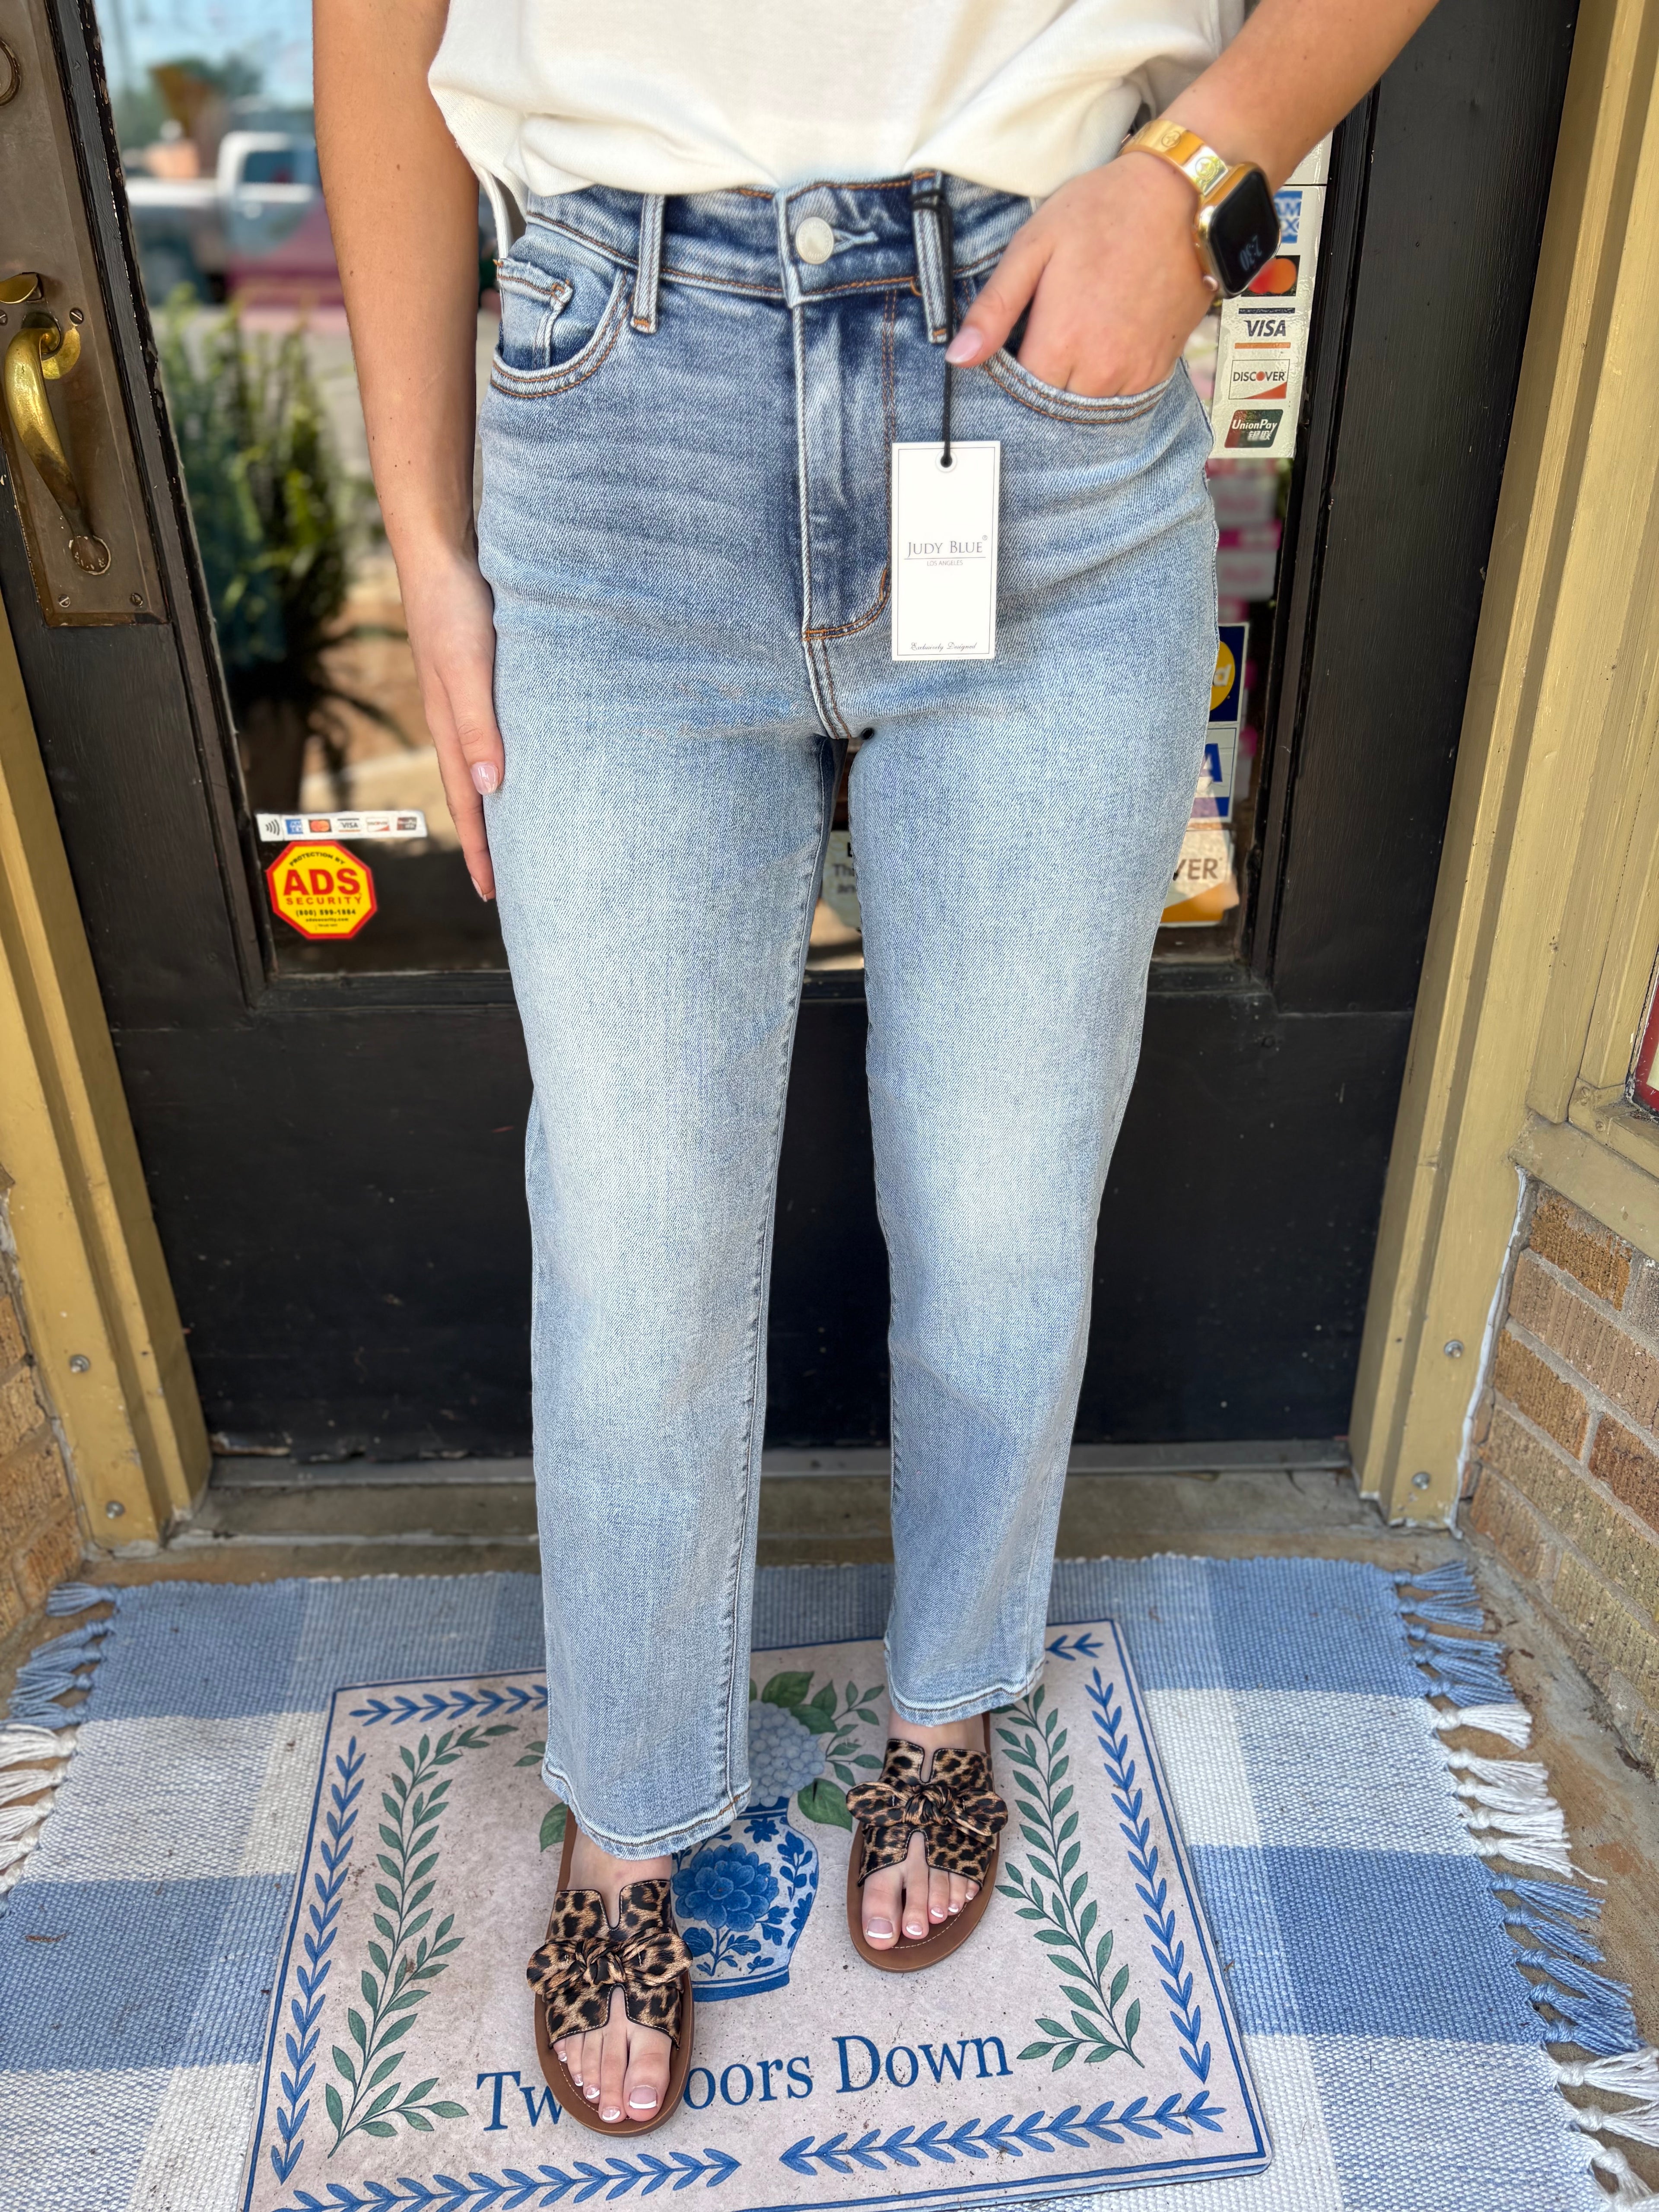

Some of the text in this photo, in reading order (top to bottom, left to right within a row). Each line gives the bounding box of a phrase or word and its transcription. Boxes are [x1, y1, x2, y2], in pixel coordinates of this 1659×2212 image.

[1243, 320, 1286, 337] VISA
[1233, 371, 1285, 381] DISCOVER
[1232, 419, 1278, 433] UnionPay
[907, 540, 982, 558] JUDY BLUE
[947, 642, 977, 652] Designed
[289, 852, 334, 867] PROTECTION
[283, 868, 360, 896] ADS
[286, 896, 361, 905] SECURITY
[476, 2035, 1014, 2131] Tw oors Down
